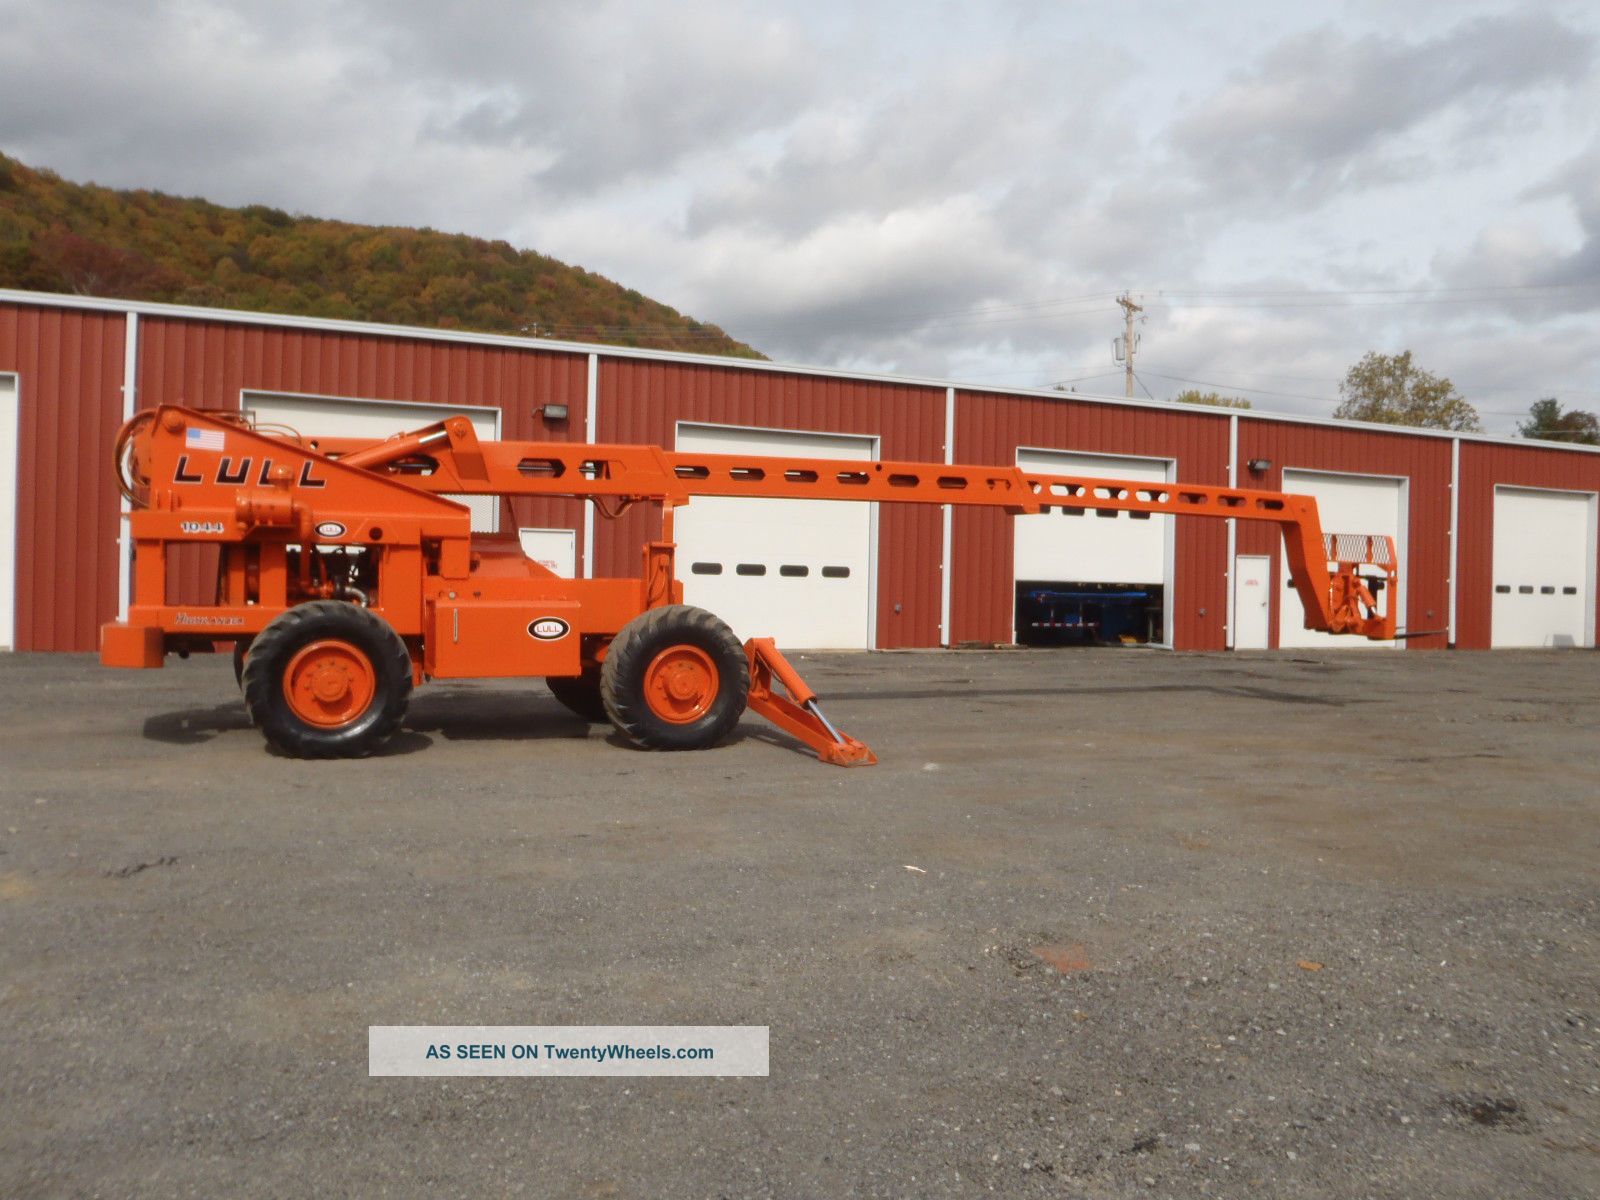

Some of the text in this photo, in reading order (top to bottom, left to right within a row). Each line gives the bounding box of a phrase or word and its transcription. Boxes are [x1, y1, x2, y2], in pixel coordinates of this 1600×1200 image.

[173, 455, 326, 488] LULL
[181, 521, 225, 534] 1044
[536, 624, 561, 633] LULL
